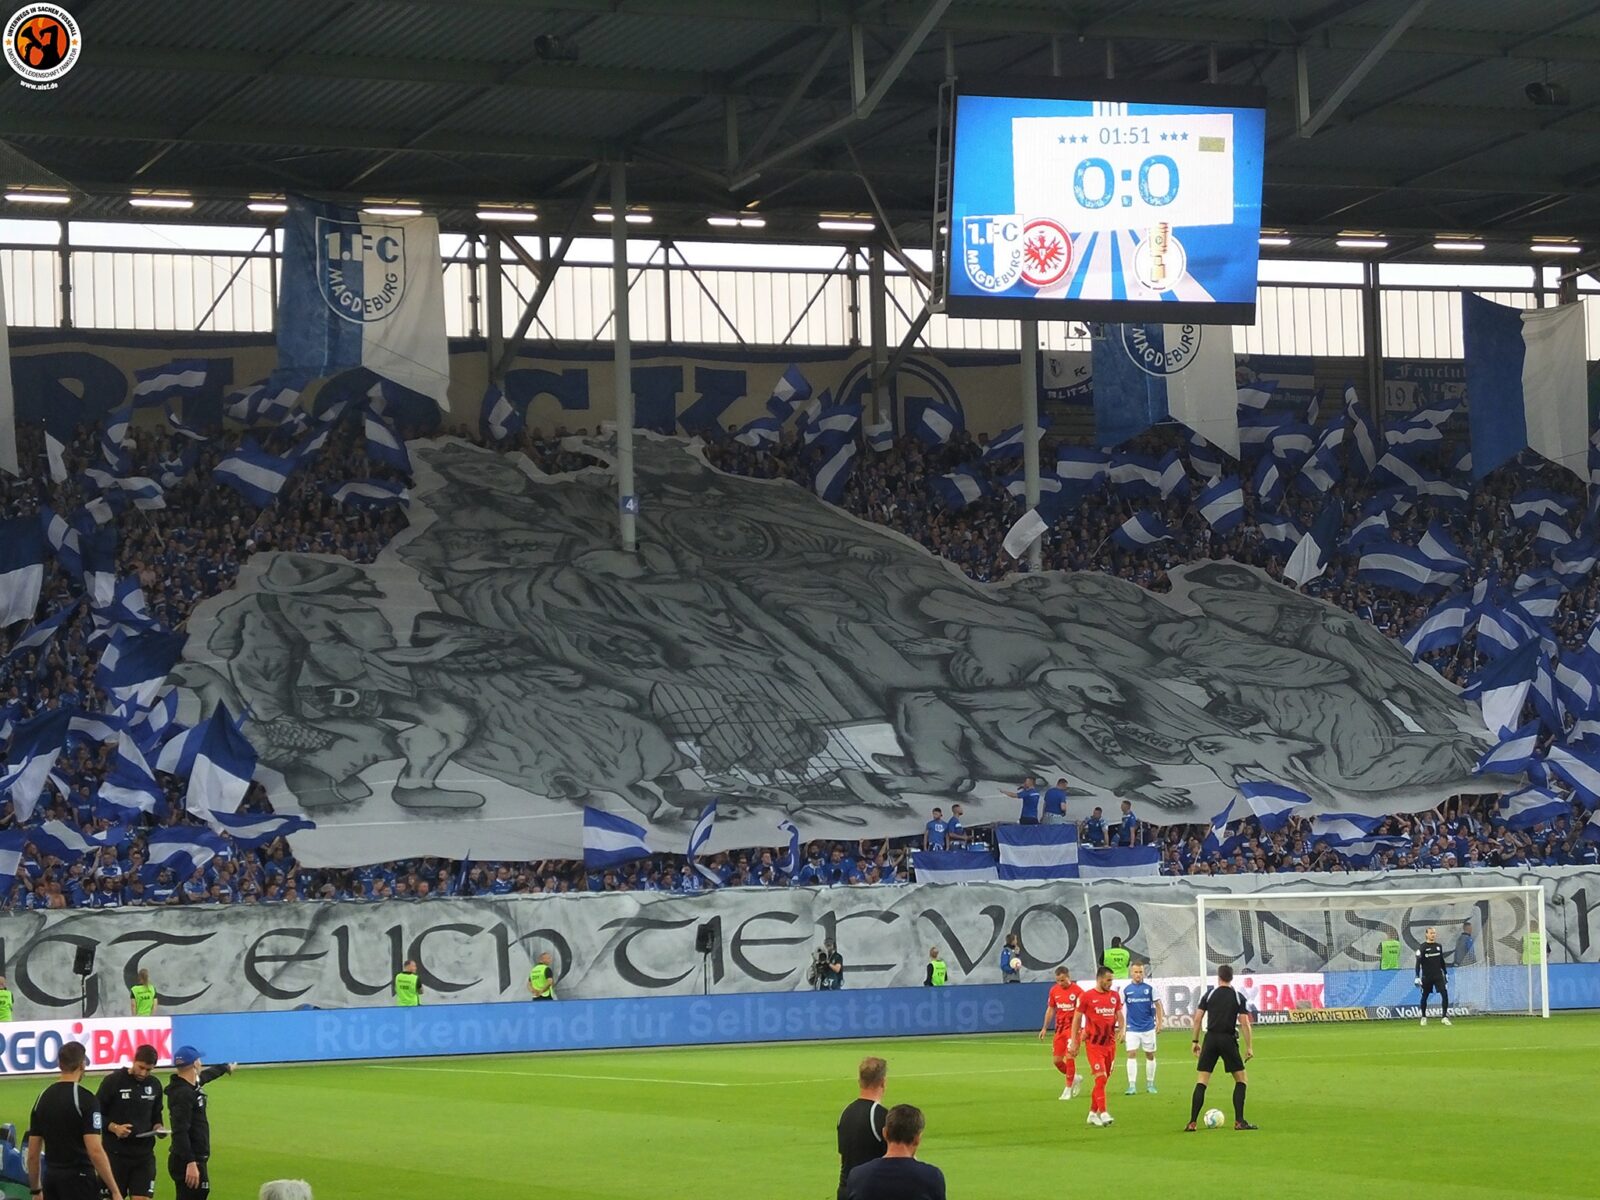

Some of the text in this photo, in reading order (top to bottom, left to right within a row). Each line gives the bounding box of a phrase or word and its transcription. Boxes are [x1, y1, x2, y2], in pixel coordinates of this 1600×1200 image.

[1099, 126, 1150, 144] 01:51
[1073, 155, 1180, 209] 0:0
[966, 249, 1021, 287] MAGDEBURG
[328, 268, 399, 314] MAGDEBURG
[1132, 324, 1194, 366] MAGDEBURG
[625, 498, 634, 511] 4
[328, 687, 360, 708] D
[919, 901, 1156, 975] VOR
[1258, 984, 1324, 1011] BANK
[1291, 1008, 1367, 1023] SPORTWETTEN
[315, 990, 1005, 1053] Rückenwind für Selbstständige
[1257, 1011, 1288, 1024] bwin
[92, 1029, 173, 1065] BANK
